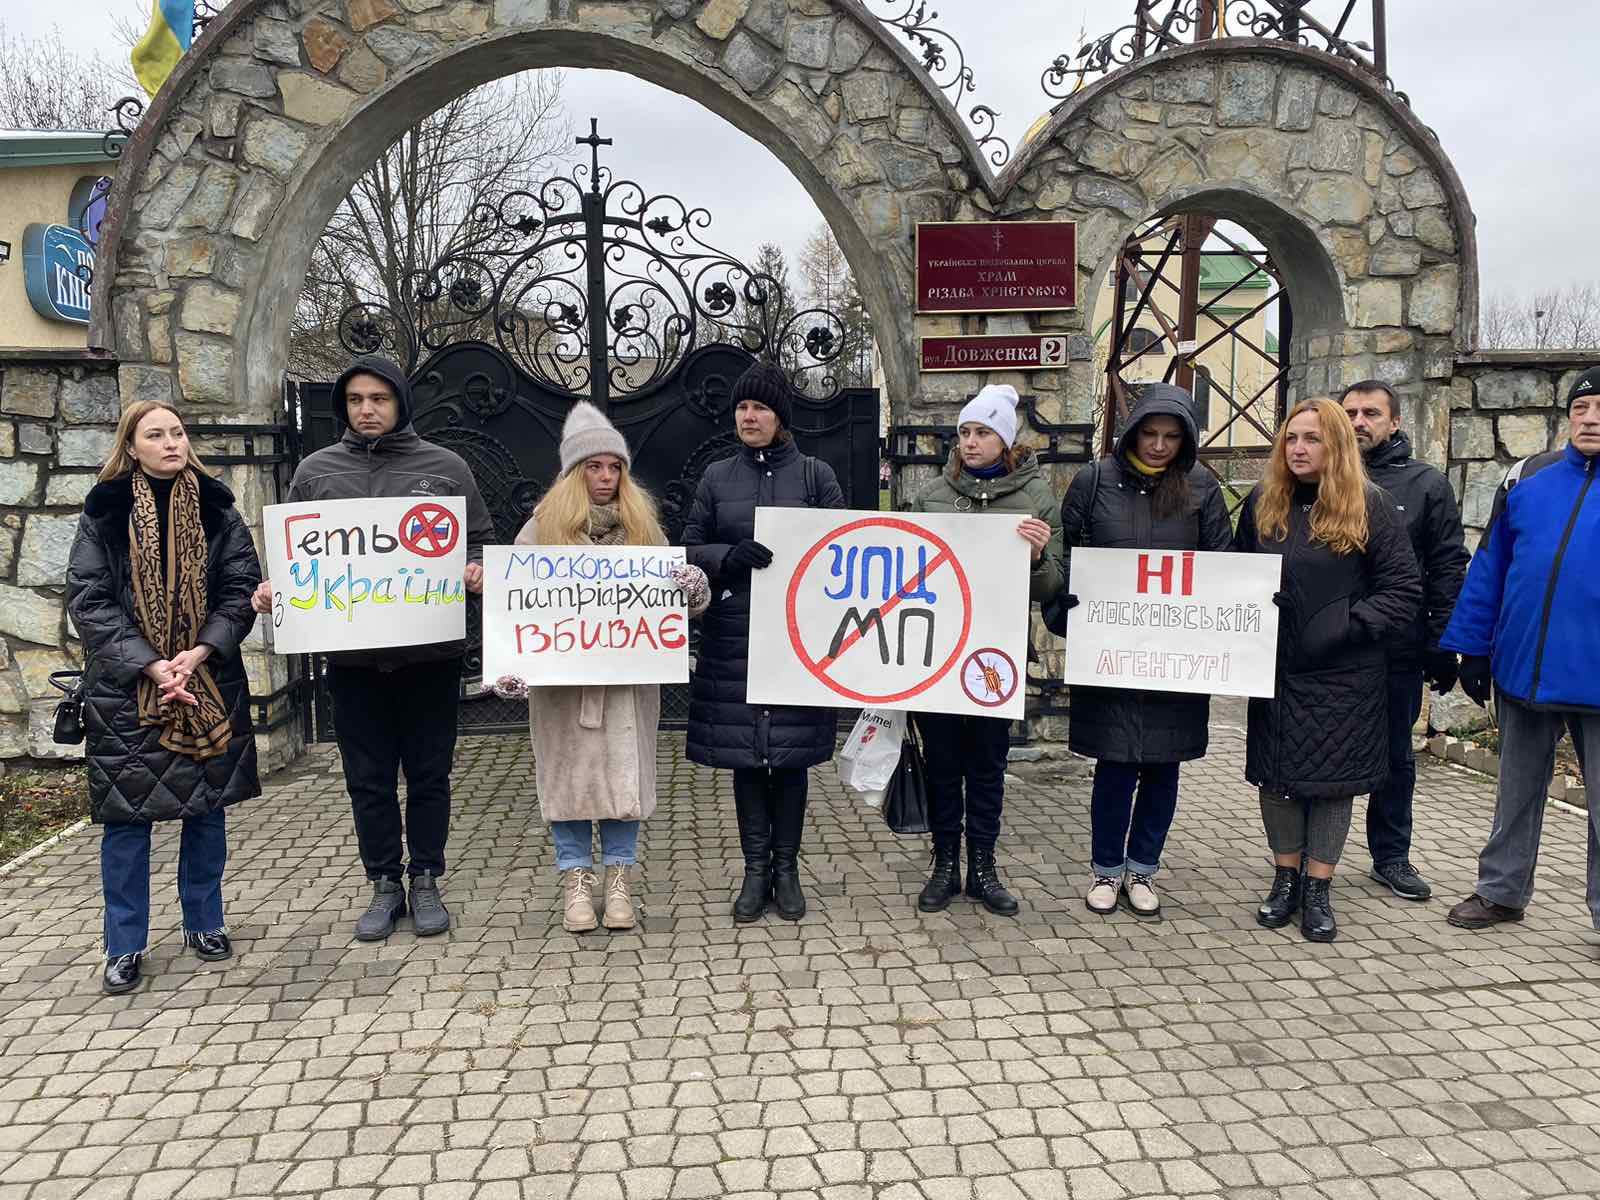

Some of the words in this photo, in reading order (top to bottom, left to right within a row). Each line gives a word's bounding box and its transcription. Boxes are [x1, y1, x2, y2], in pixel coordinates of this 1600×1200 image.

[977, 271, 1017, 282] ХРАМ
[979, 257, 1034, 266] ПОСЛАВНА
[928, 287, 975, 299] РІЗДВА
[981, 285, 1067, 297] ХРИСТОВОГО
[944, 345, 1038, 366] Довженка
[1045, 340, 1061, 362] 2
[284, 513, 398, 560] Геть
[824, 544, 937, 604] УПЦ
[1136, 552, 1195, 596] НІ
[289, 559, 465, 622] України
[1087, 601, 1261, 633] МОСКОВСЬКІЙ
[828, 607, 935, 667] МП
[1096, 650, 1231, 682] АГЕНТУРІ
